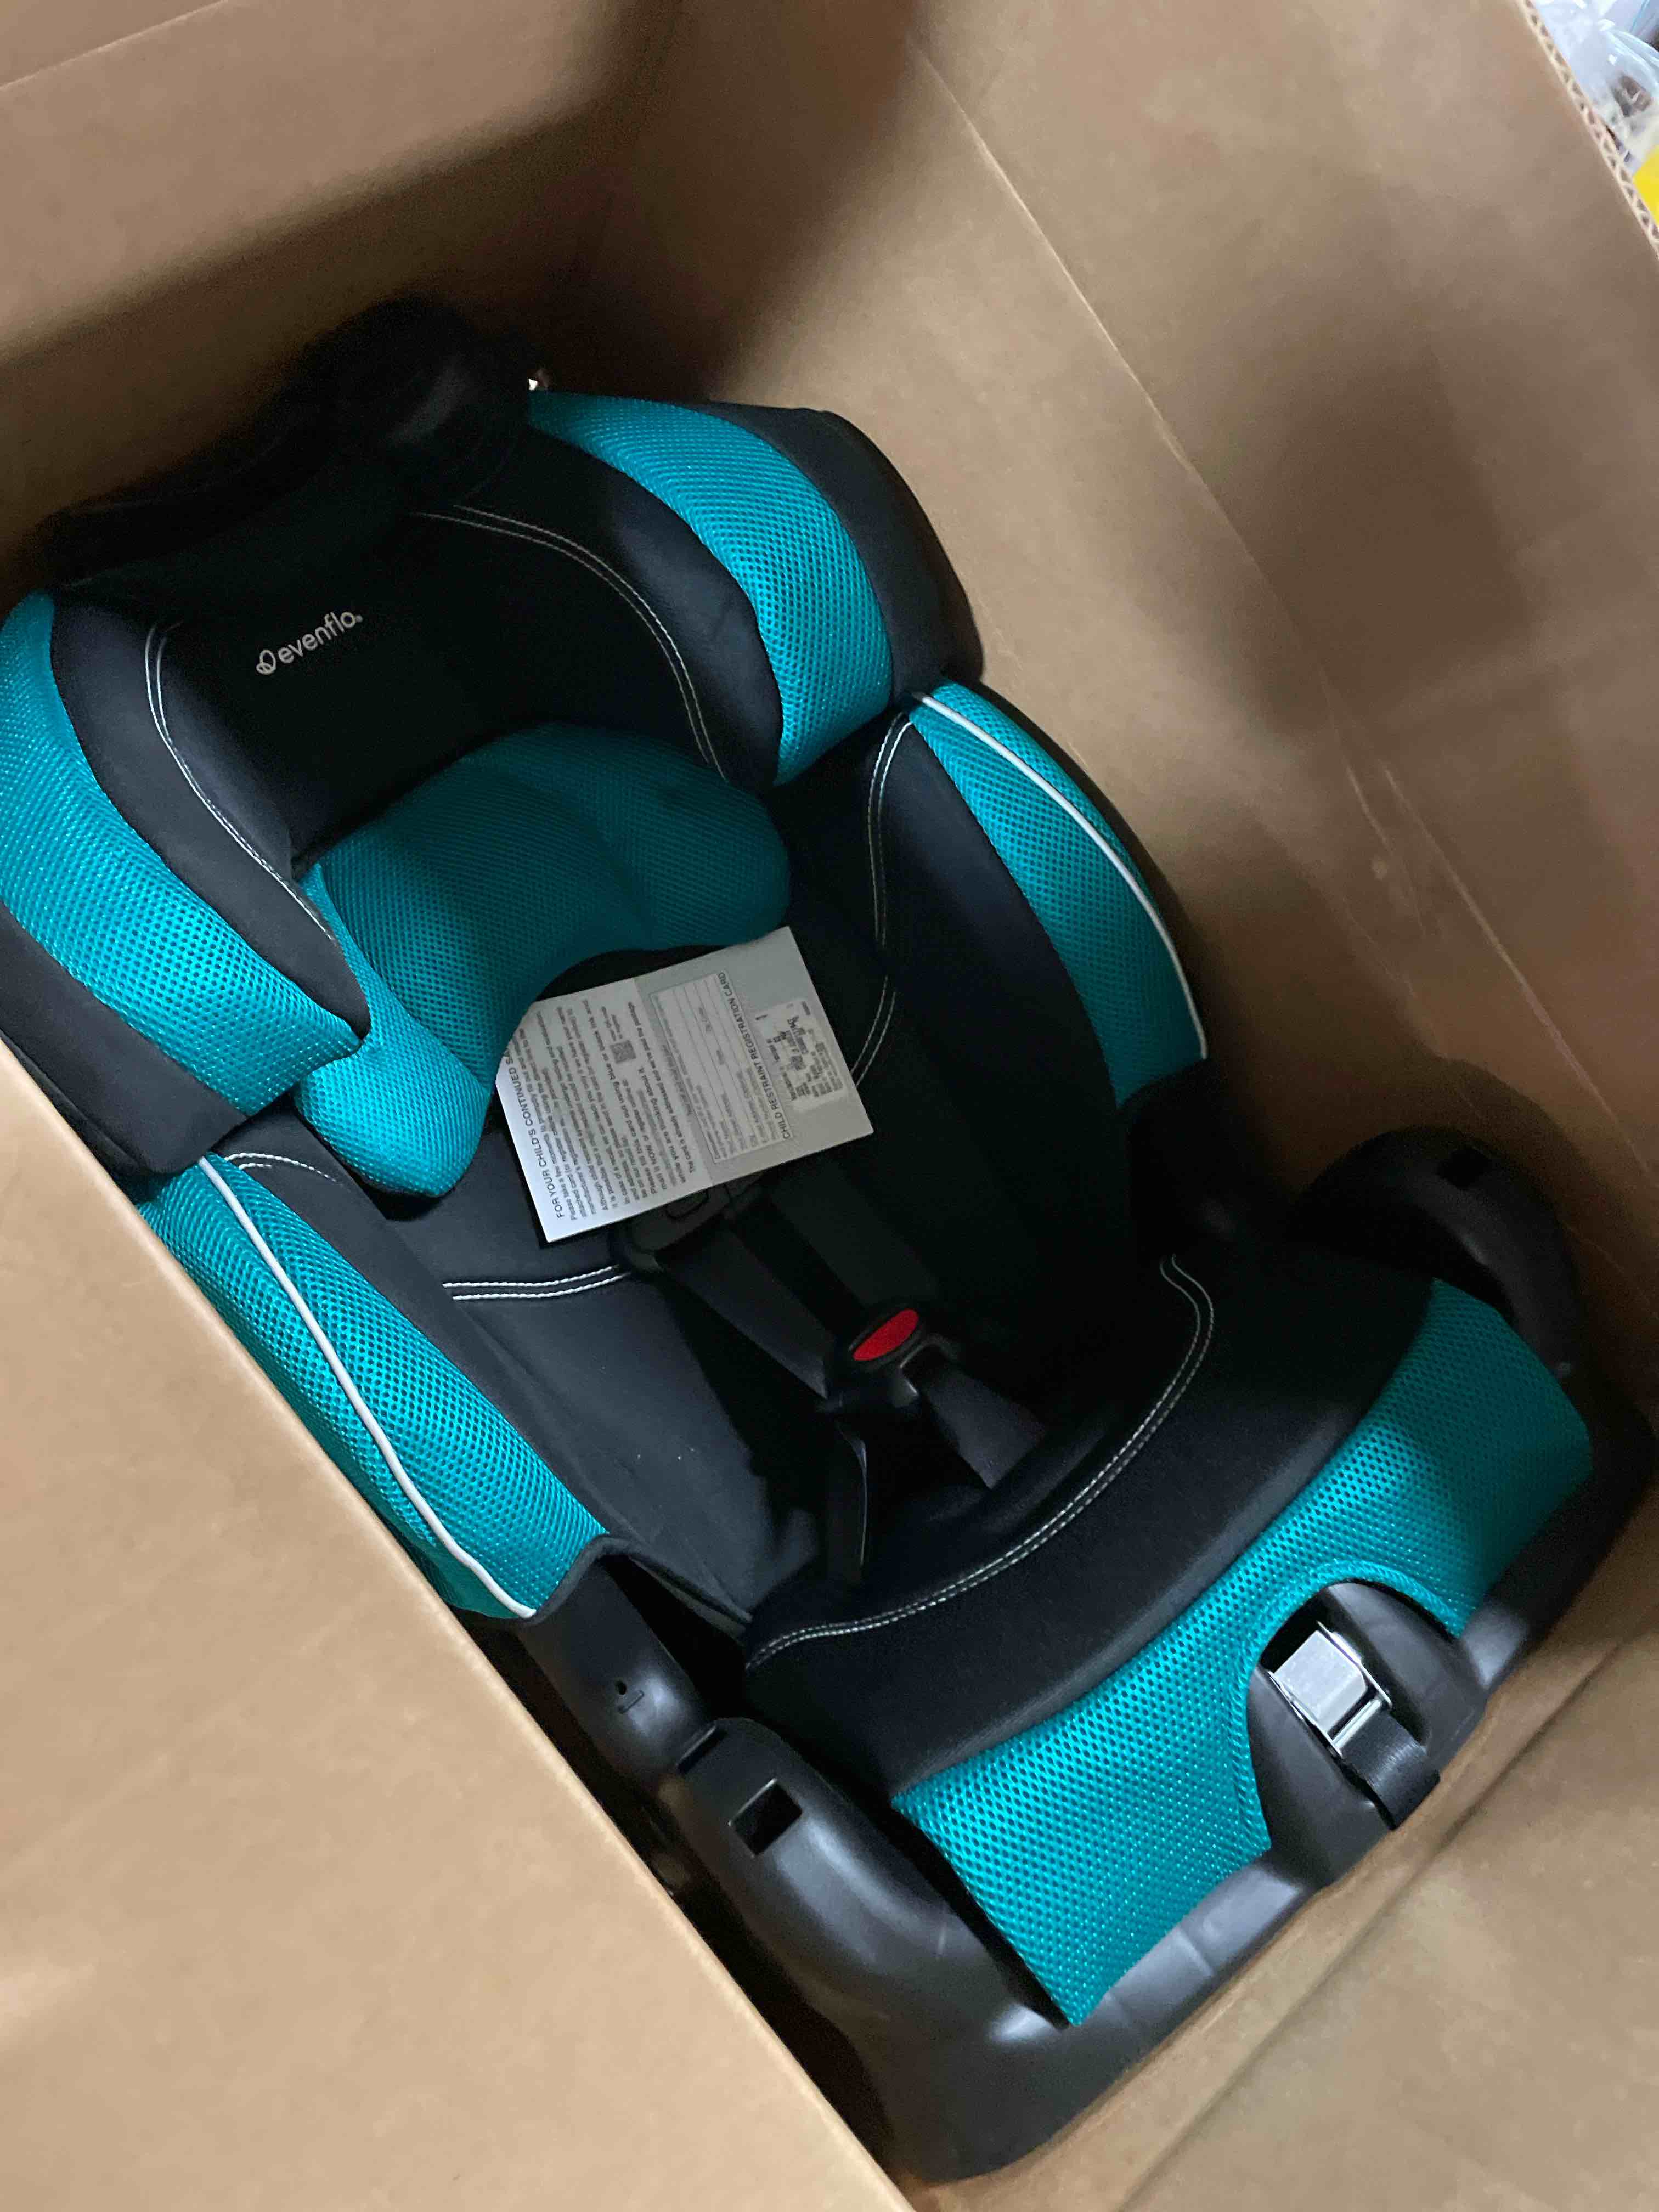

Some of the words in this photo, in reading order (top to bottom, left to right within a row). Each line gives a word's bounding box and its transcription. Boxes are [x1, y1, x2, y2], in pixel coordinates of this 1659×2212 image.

[278, 612, 356, 663] evenflo
[717, 971, 733, 997] CARD
[727, 997, 759, 1060] REGISTRATION
[507, 1066, 534, 1127] CONTINUED
[753, 1060, 779, 1110] RESTRAINT
[774, 1111, 791, 1139] CHILD
[527, 1128, 547, 1167] CHILD'S
[541, 1169, 557, 1197] YOUR
[551, 1197, 565, 1218] FOR
